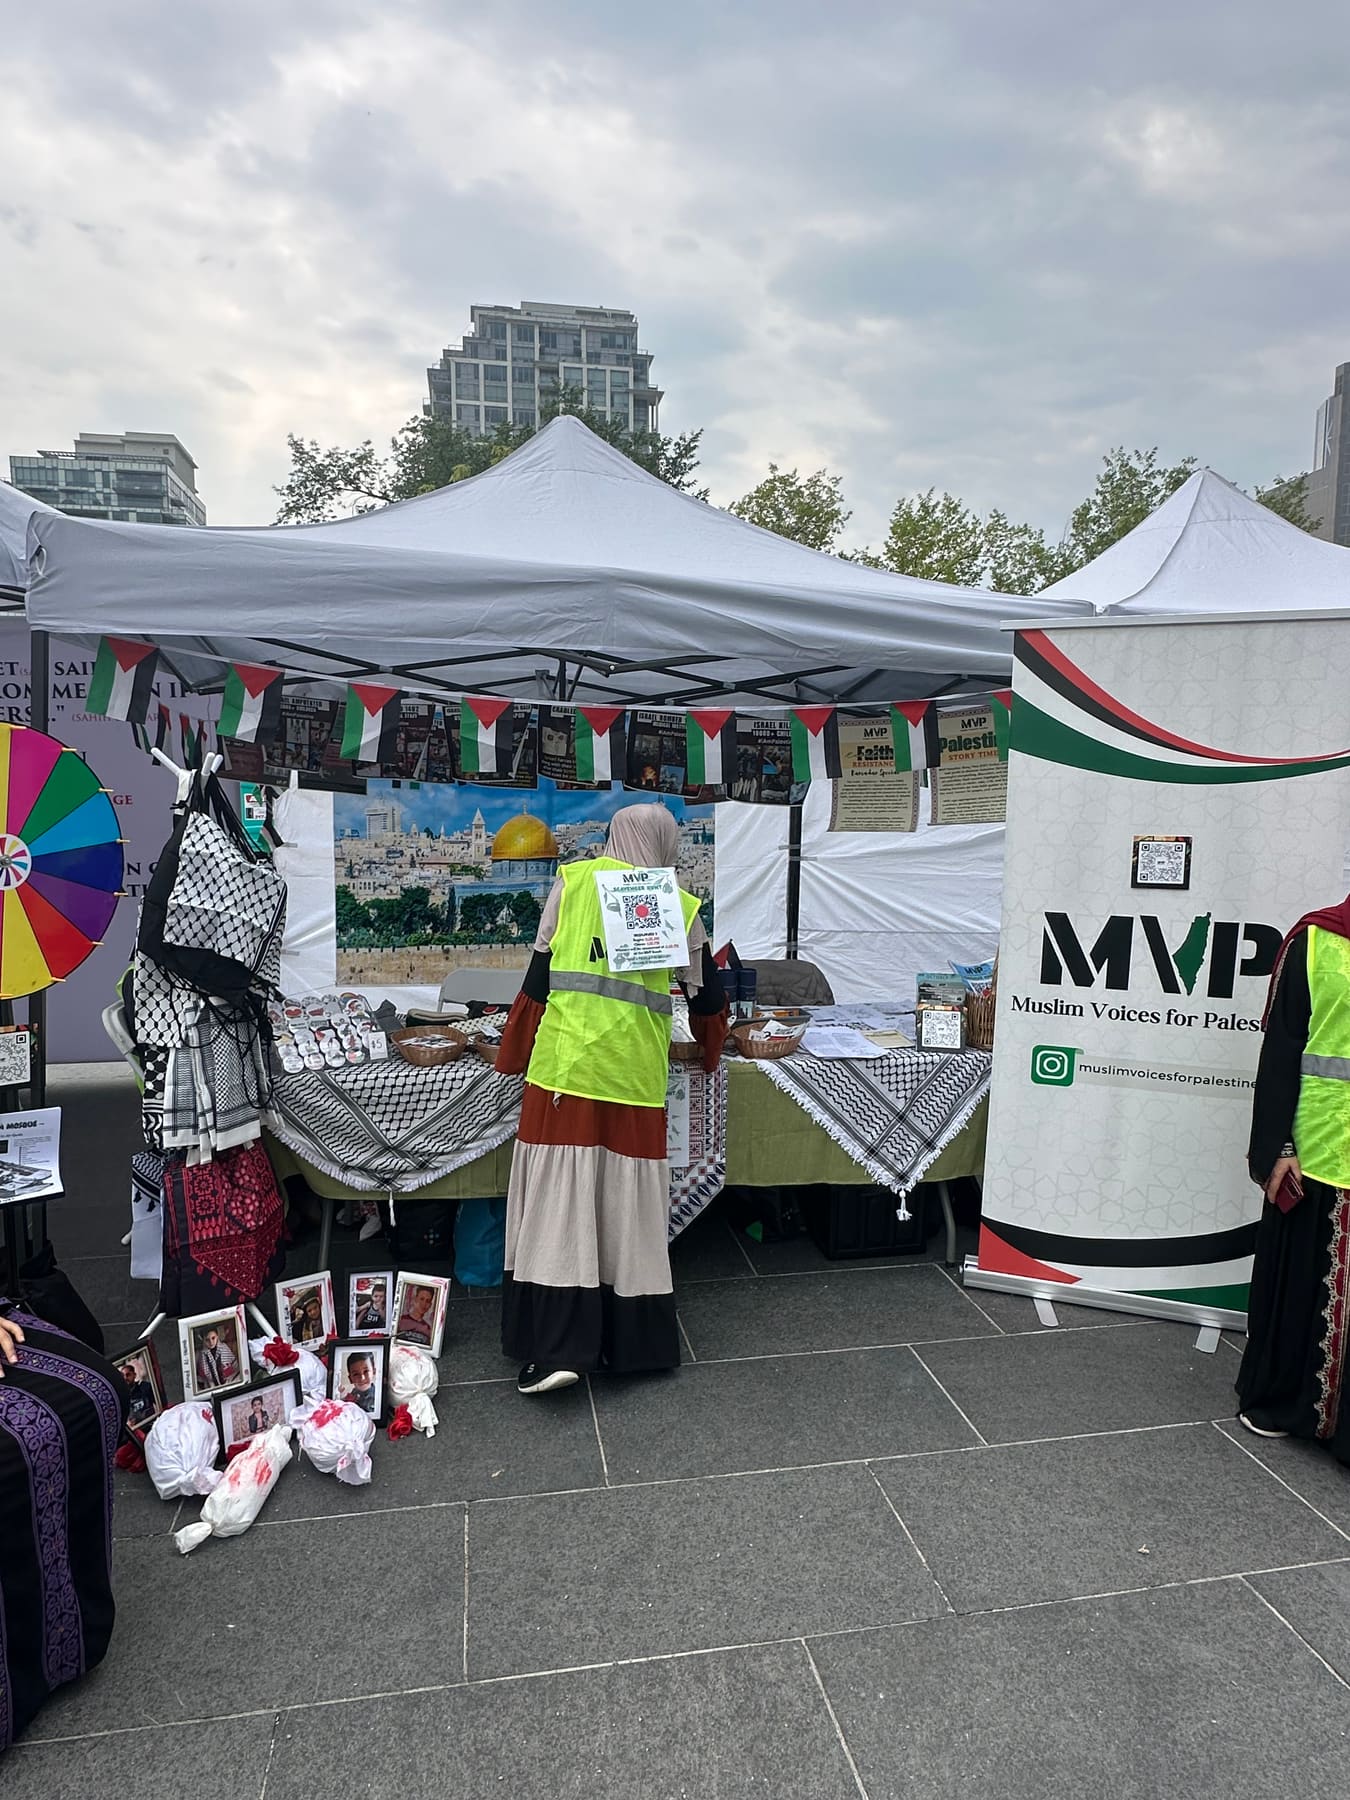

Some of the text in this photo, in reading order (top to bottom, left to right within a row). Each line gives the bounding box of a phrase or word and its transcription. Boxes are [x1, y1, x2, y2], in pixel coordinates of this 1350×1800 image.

[52, 683, 87, 699] ME
[753, 721, 776, 729] ISRAEL
[960, 717, 987, 729] MVP
[863, 728, 888, 738] MVP
[857, 744, 894, 761] Faith
[948, 752, 975, 761] STORY
[852, 760, 894, 768] RESISTANC
[622, 872, 649, 883] MVP
[1040, 911, 1284, 1000] MVP
[1010, 995, 1084, 1017] Muslim
[1090, 1001, 1161, 1024] Voices
[1165, 1008, 1199, 1027] for
